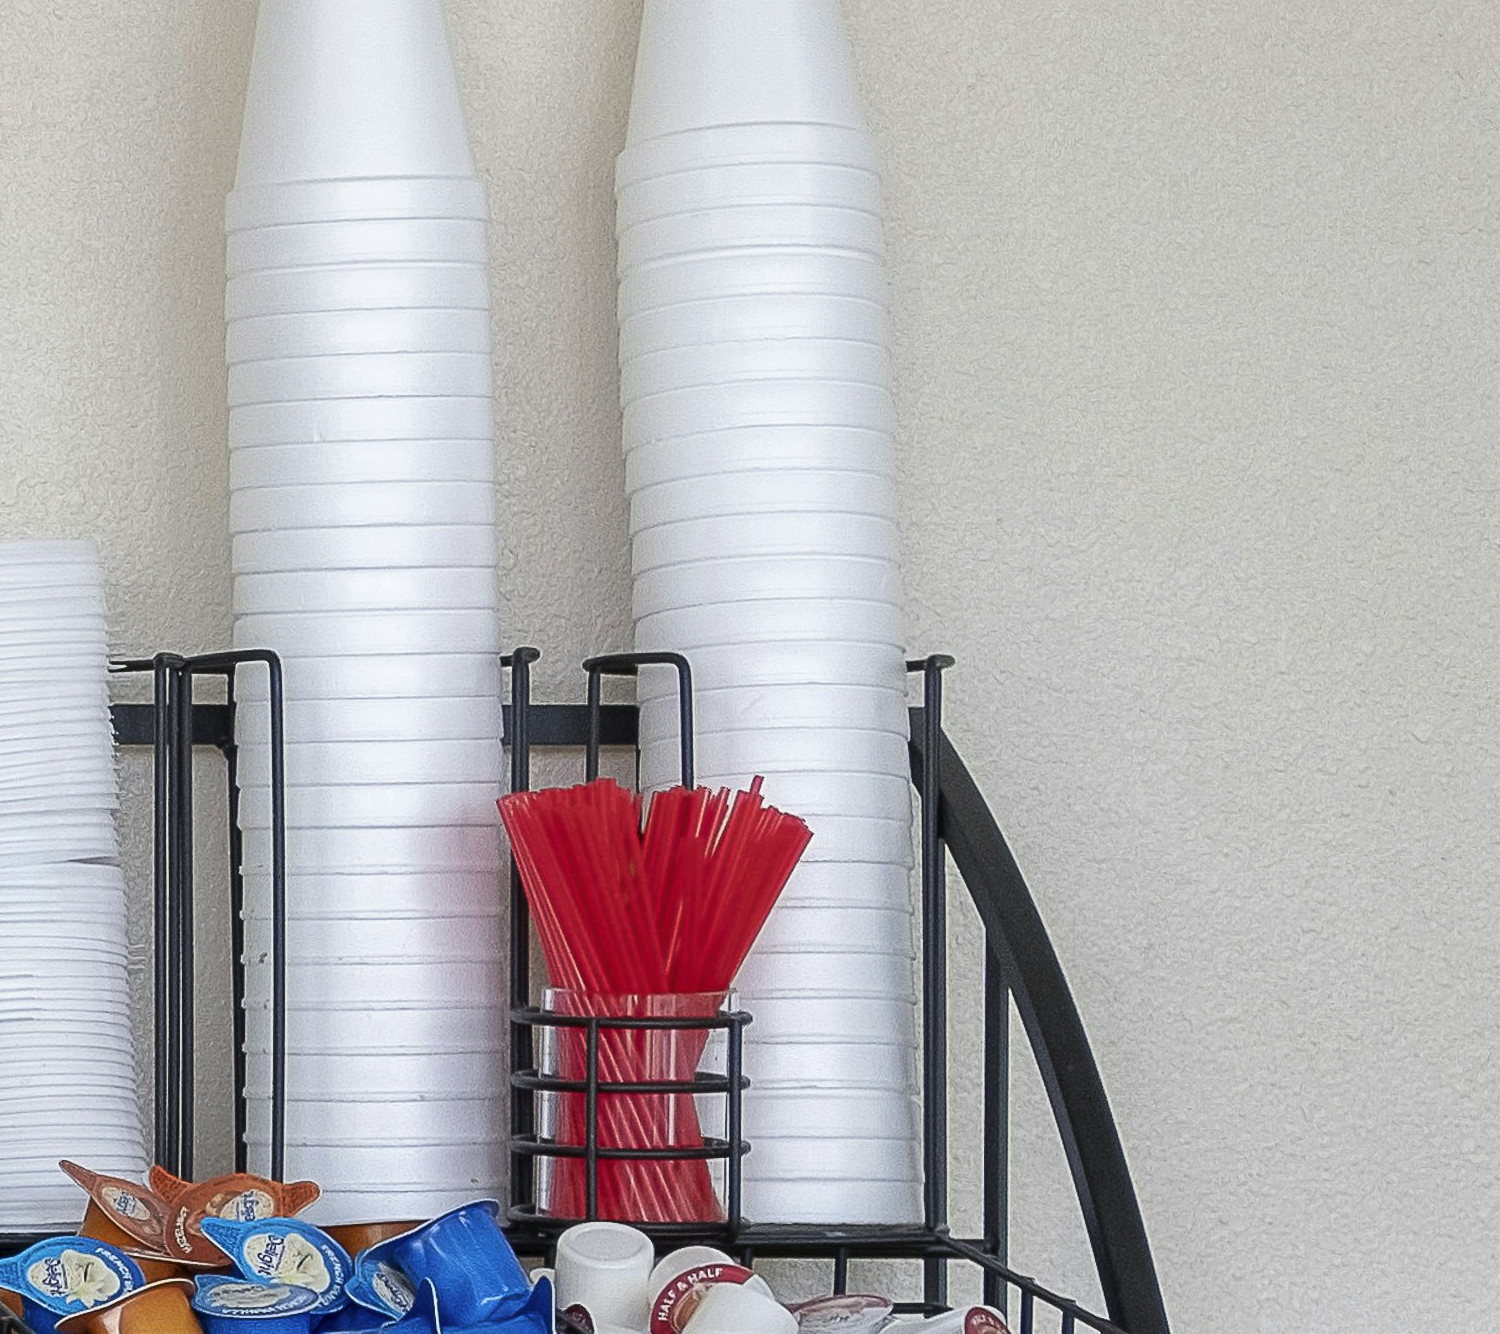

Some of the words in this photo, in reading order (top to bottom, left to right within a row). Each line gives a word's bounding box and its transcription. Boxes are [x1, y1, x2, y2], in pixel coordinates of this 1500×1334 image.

[257, 1234, 285, 1275] Delight
[657, 1290, 677, 1322] HALF
[676, 1280, 688, 1292] &
[688, 1267, 724, 1285] HALF
